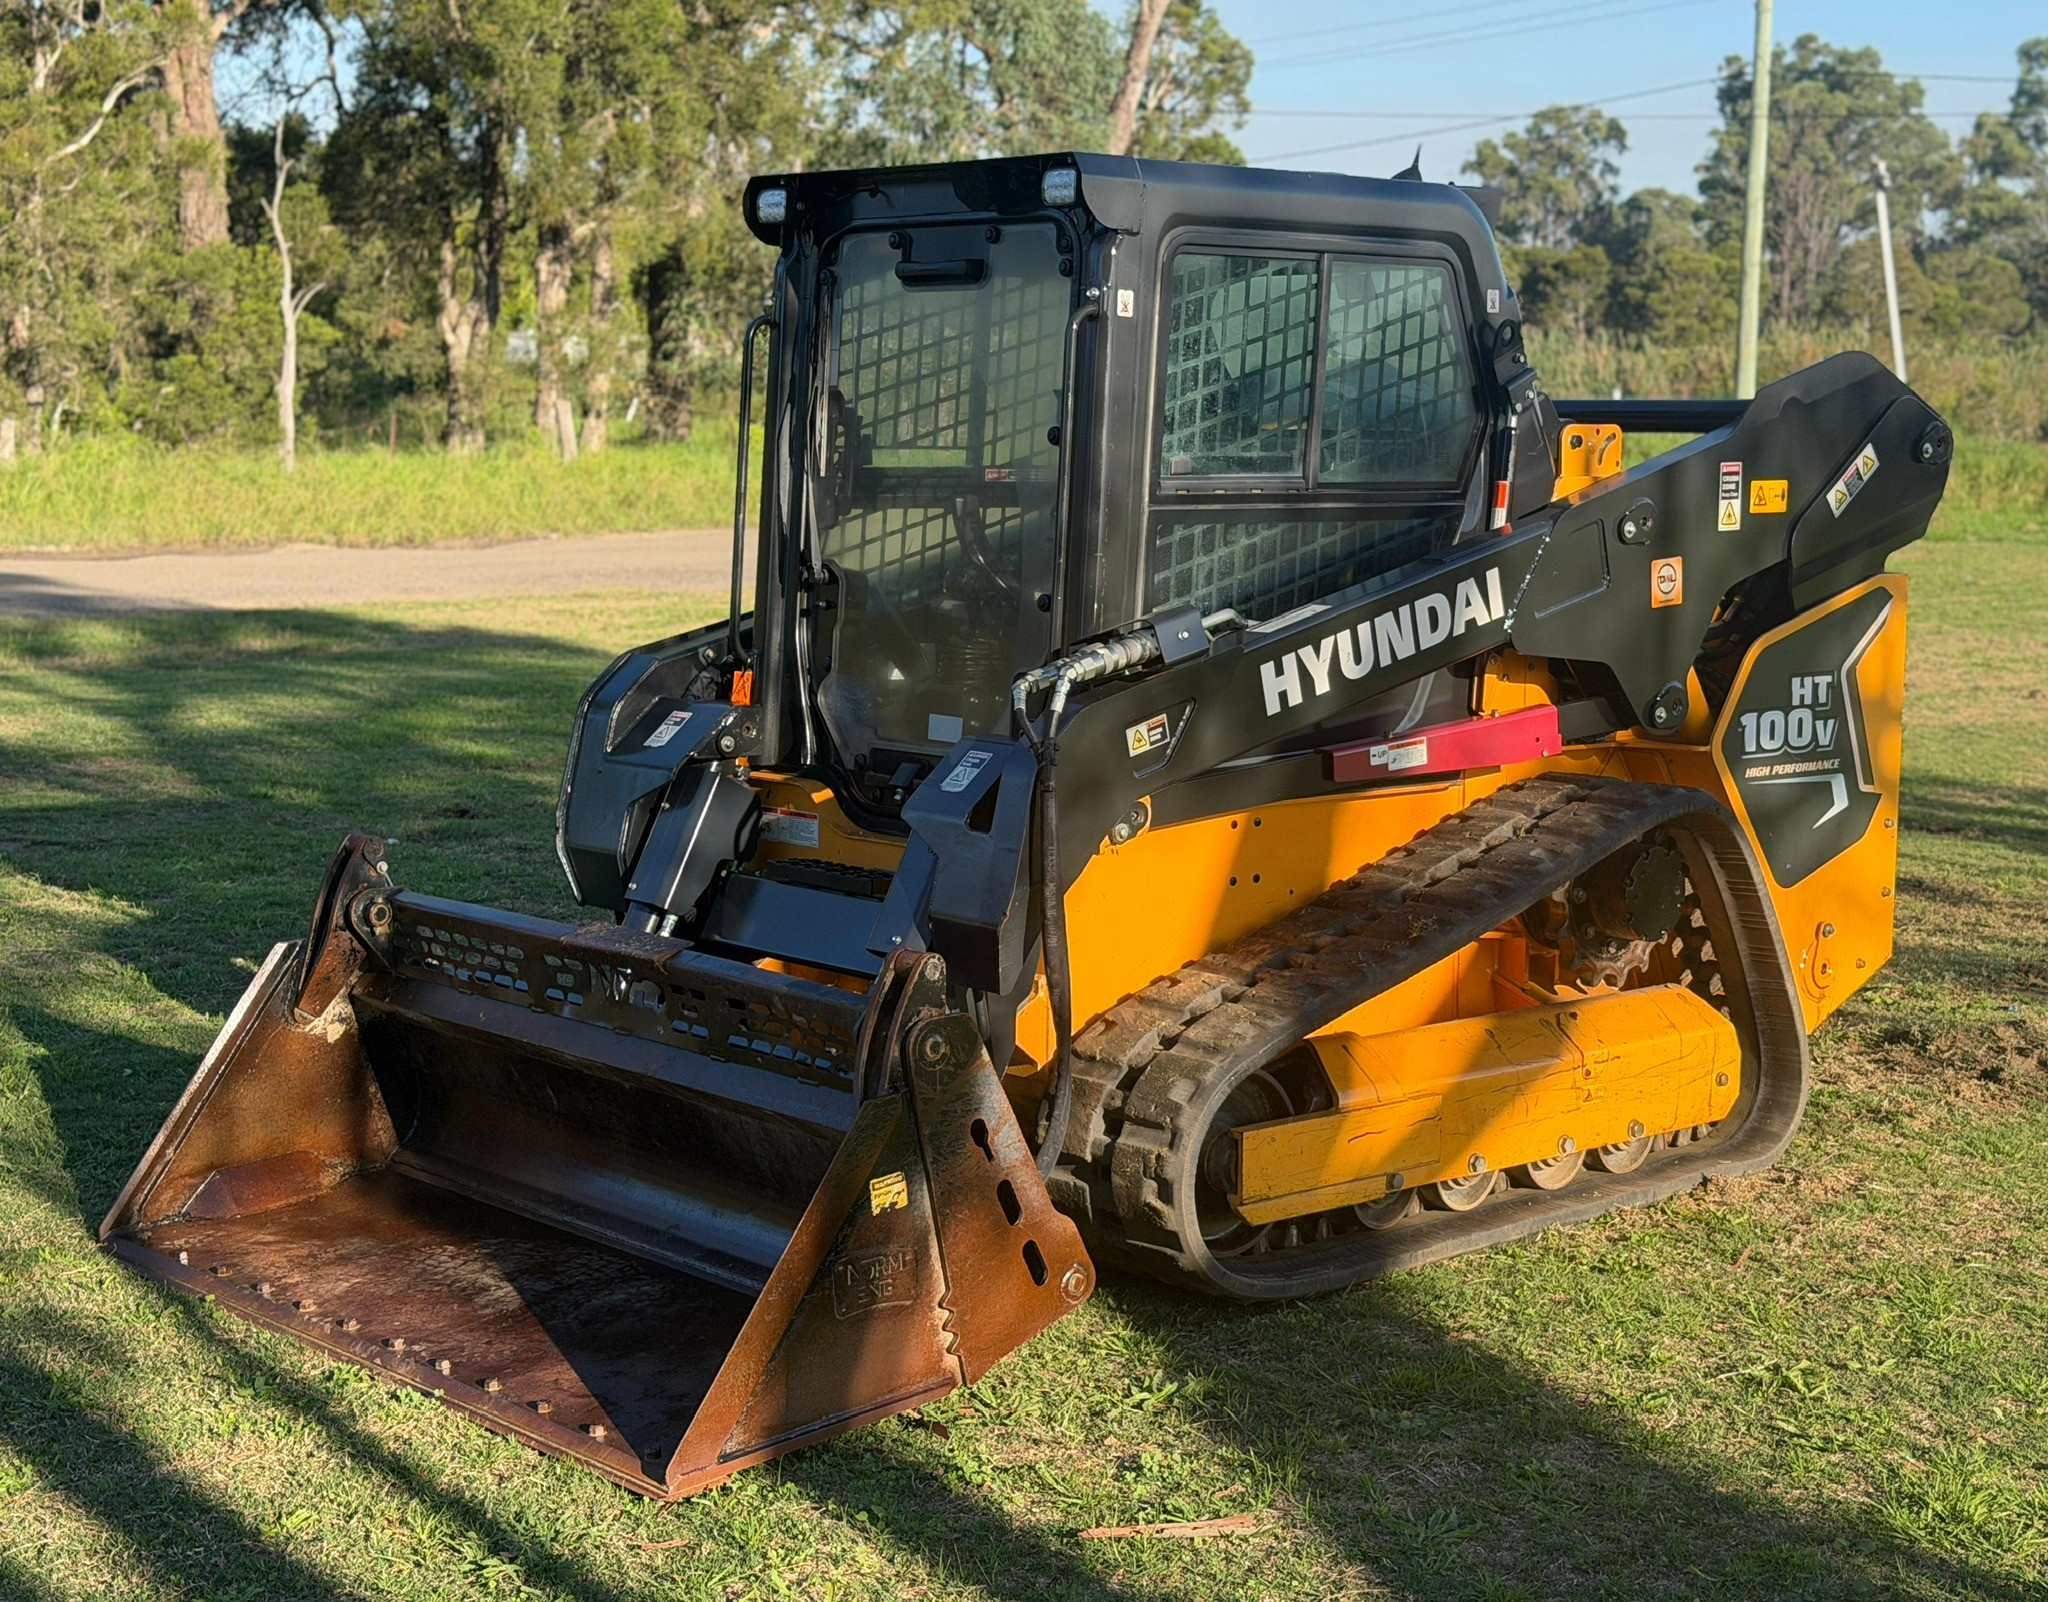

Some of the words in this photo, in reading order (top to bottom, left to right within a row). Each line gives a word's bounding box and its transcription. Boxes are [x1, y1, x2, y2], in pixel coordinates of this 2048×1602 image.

[1260, 567, 1504, 717] HYUNDAI
[1791, 675, 1832, 706] HT
[1745, 765, 1771, 778] HIGH
[1771, 758, 1840, 775] PERFORMANCE
